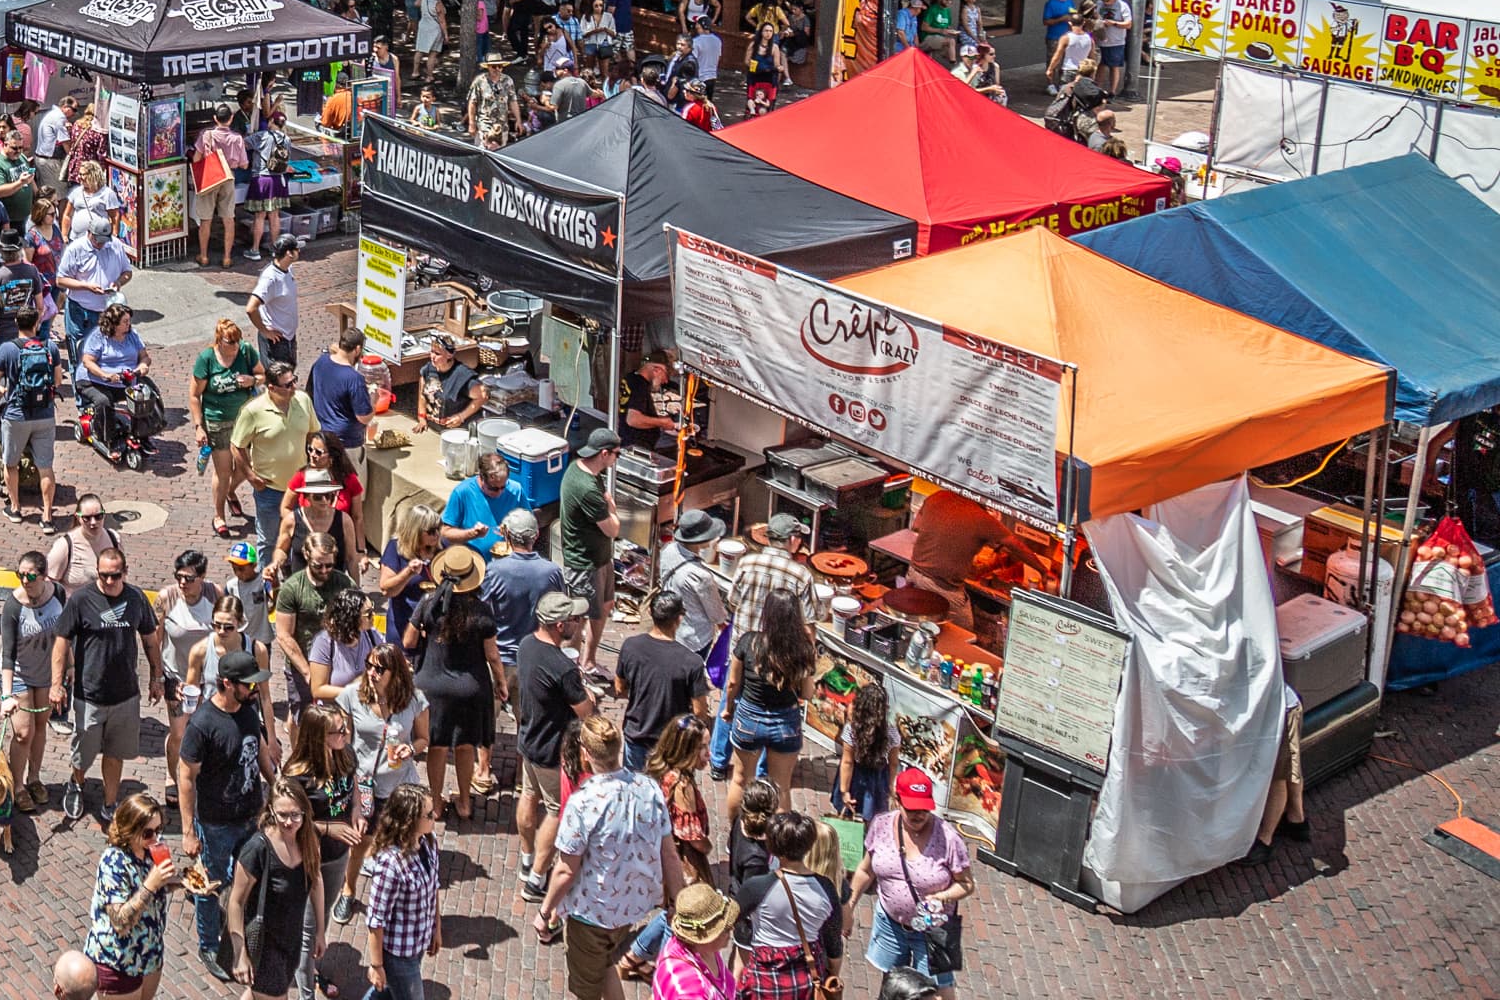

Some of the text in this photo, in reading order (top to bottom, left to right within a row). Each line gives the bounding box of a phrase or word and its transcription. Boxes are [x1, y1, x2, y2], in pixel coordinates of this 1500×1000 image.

[1230, 10, 1297, 39] POTATO
[1384, 13, 1461, 51] BAR
[14, 21, 133, 77] MERCH BOOTH
[162, 32, 356, 78] MERCH BOOTH
[1301, 56, 1375, 83] SAUSAGE
[1379, 66, 1458, 94] SANDWICHES
[376, 138, 598, 250] HAMBURGERS RIBBON FRIES
[1068, 200, 1121, 231] CORN
[687, 235, 760, 271] SAVORY
[734, 284, 763, 301] AVOCADO
[809, 298, 899, 357] Crêpe
[880, 340, 919, 365] CRAZY
[966, 336, 1043, 372] SWEET
[972, 354, 1036, 381] NUTELLA BANANA
[746, 378, 766, 393] YOU
[960, 394, 983, 409] DULCE
[984, 404, 994, 413] DE
[995, 407, 1018, 421] LECHE
[1019, 416, 1045, 433] TURTLE
[960, 417, 1043, 454] SWEET CHEESE DELIGHT
[957, 455, 973, 467] we
[966, 467, 997, 486] cater
[100, 621, 131, 629] HONDA
[1018, 610, 1051, 628] SAVORY
[1084, 635, 1114, 651] SWEET
